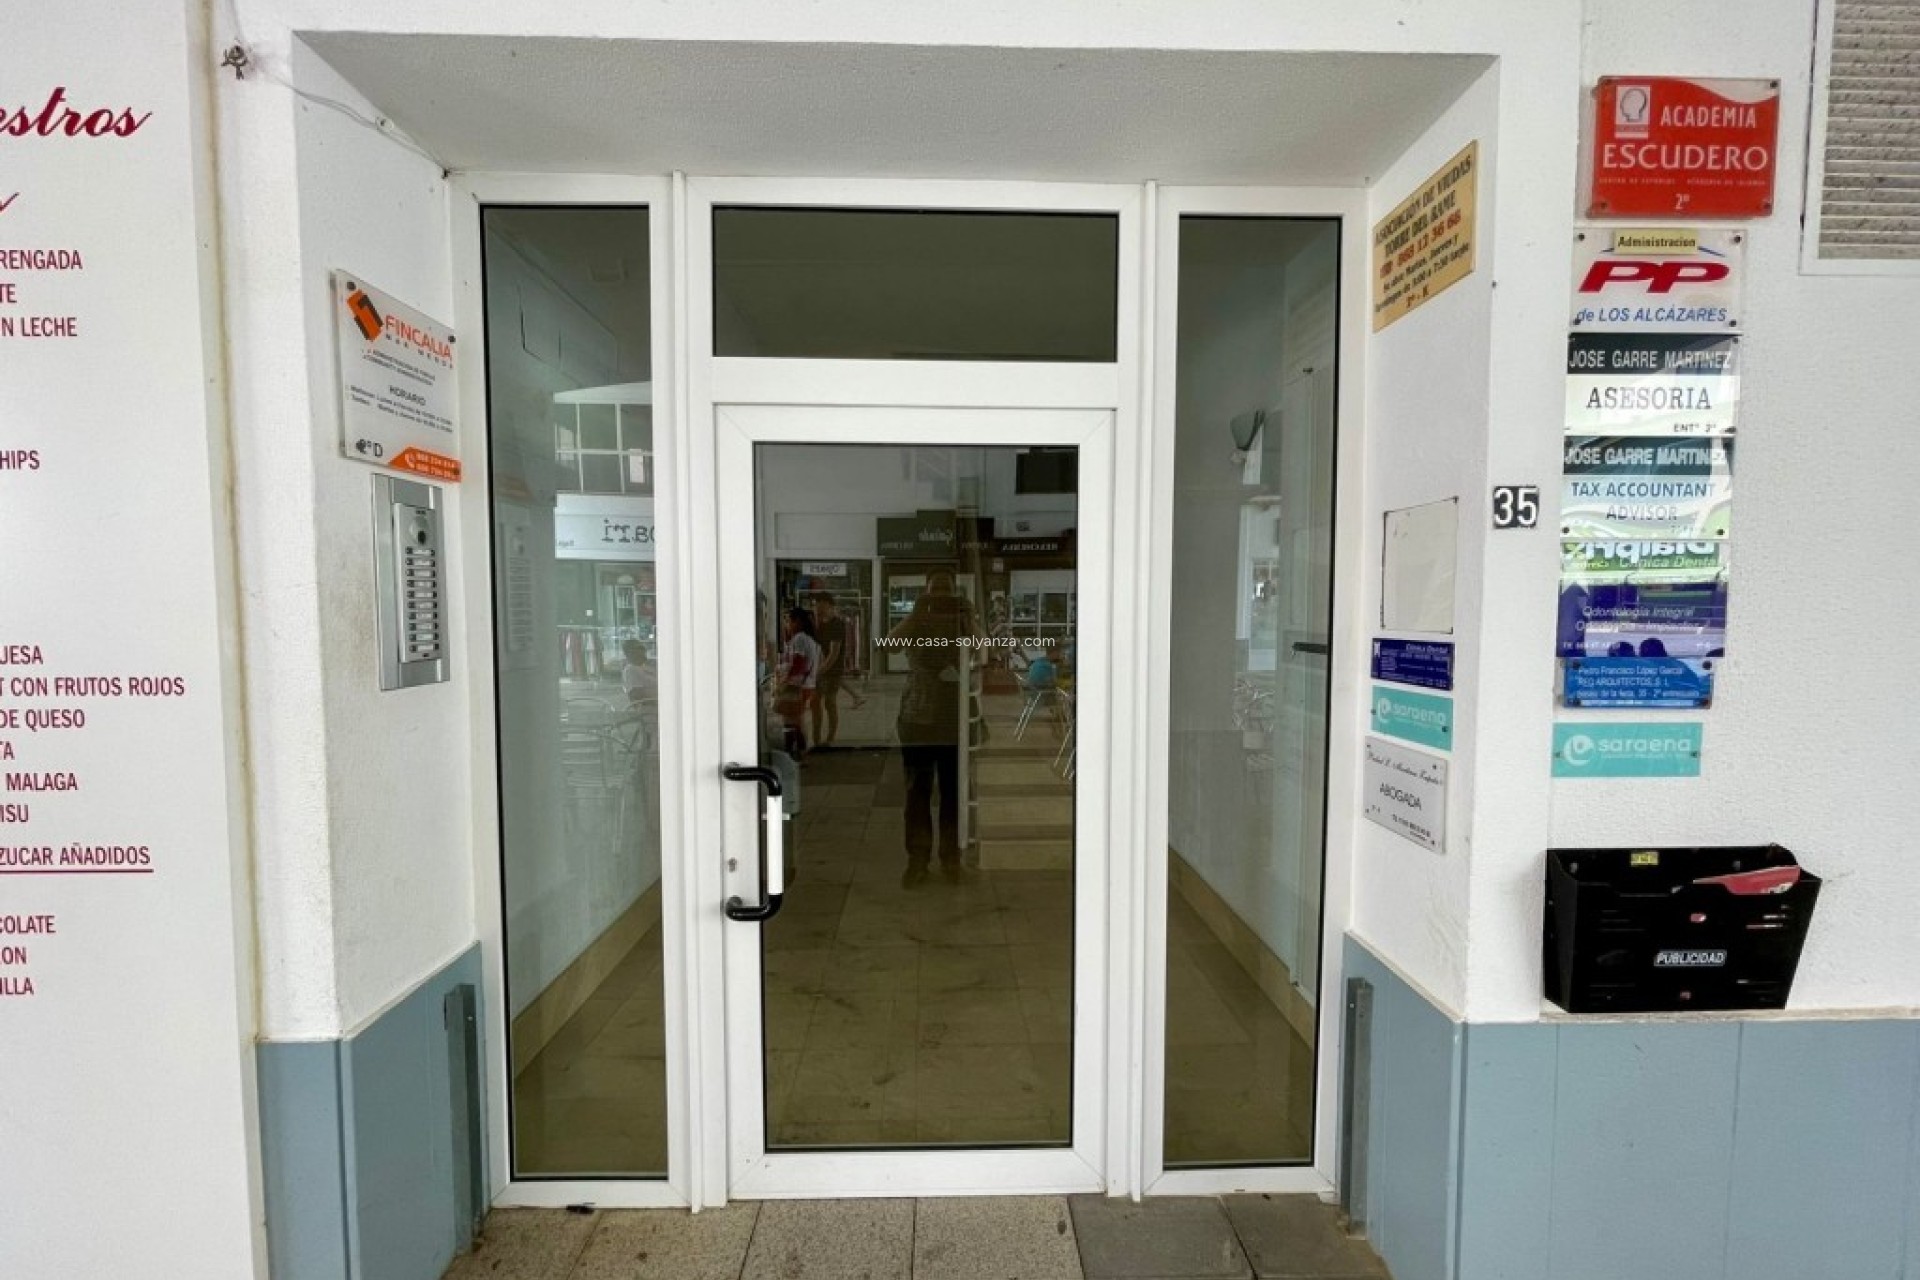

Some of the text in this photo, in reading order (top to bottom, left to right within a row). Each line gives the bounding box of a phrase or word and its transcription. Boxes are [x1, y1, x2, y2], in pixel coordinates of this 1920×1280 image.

[1660, 104, 1757, 128] ACADEMIA
[1602, 144, 1769, 171] ESCUDERO
[1578, 261, 1730, 293] PP
[1577, 303, 1728, 322] de LOS ALCÁZARES
[21, 317, 78, 336] LECHE
[385, 315, 452, 359] FINCALIA
[1569, 350, 1732, 369] JOSE GARRE MARTINEZ
[1586, 386, 1713, 410] ASESORIA
[1564, 448, 1602, 465] JOSE
[1605, 448, 1653, 465] GARRE
[1571, 482, 1716, 498] TAX ACCOUNTANT
[1493, 487, 1538, 526] 35
[1606, 504, 1679, 521] ADVISOR
[10, 677, 48, 696] CON
[54, 677, 122, 696] FRUTOS
[129, 677, 185, 696] ROJOS
[25, 710, 86, 732] QUESO
[6, 773, 79, 791] MALAGA
[1379, 782, 1422, 811] ABOGADA
[59, 842, 151, 866] AÑADIDOS
[0, 946, 28, 964] ON
[1656, 951, 1725, 965] PUBLICIDAD
